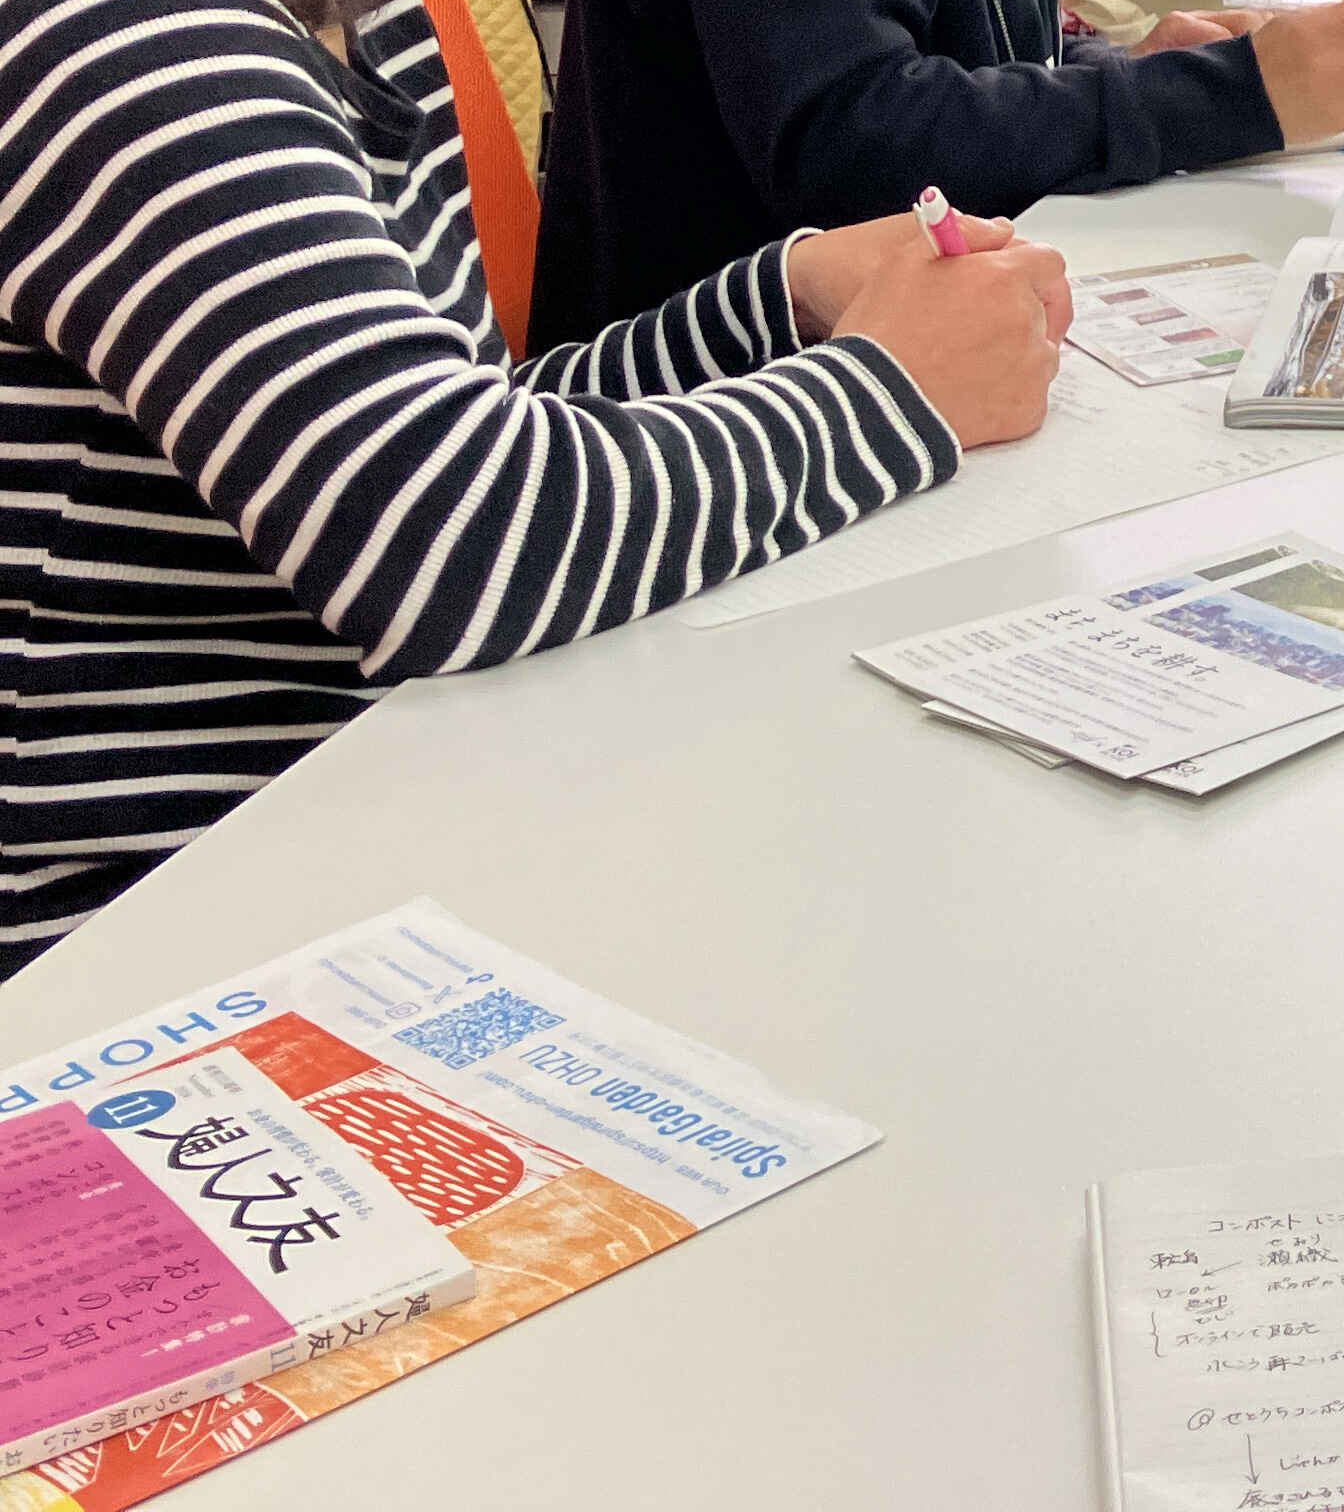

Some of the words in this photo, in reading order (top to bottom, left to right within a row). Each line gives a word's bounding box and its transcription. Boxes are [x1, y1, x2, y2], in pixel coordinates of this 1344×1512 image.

[518, 1044, 602, 1086] OHZU
[103, 1095, 159, 1125] 11
[590, 1077, 703, 1137] Garden
[676, 1123, 787, 1179] Spiral
[134, 1116, 341, 1275] 婦人之友
[308, 1291, 431, 1360] 婦人之友
[42, 1389, 190, 1454] もっと知りたい
